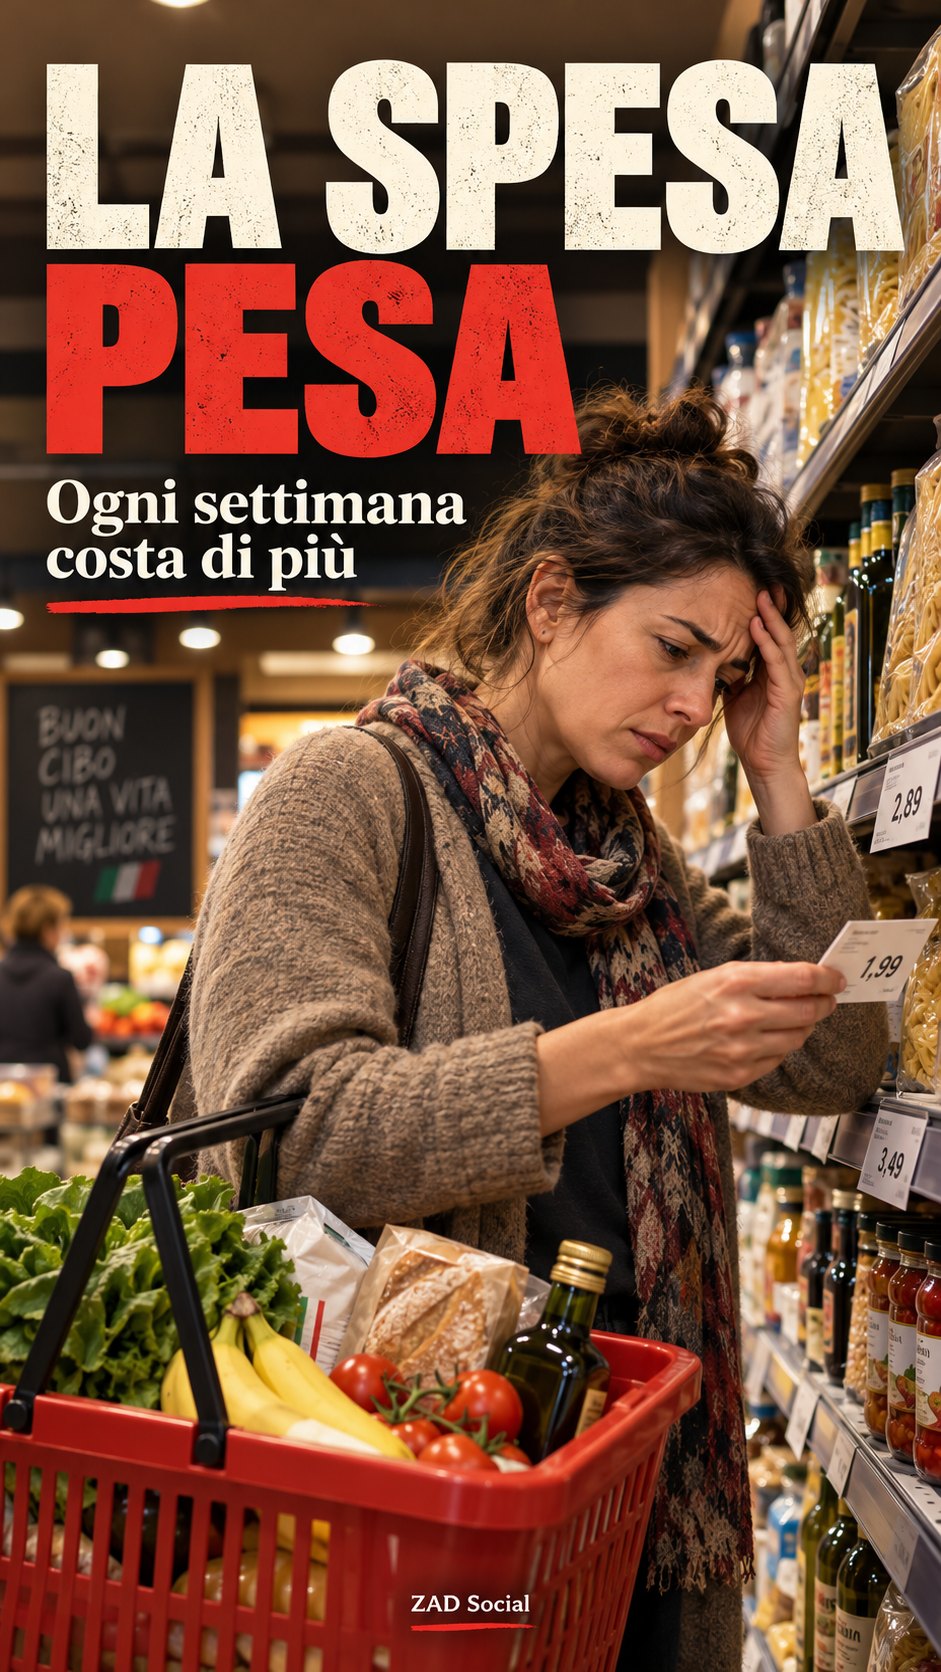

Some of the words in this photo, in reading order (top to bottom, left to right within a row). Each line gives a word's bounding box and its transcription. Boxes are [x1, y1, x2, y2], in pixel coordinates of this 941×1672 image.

[39, 705, 126, 747] BUON
[38, 745, 116, 786] CIBO
[42, 785, 102, 823] UNA
[110, 775, 173, 814] VITA
[890, 785, 923, 824] 2,89
[35, 815, 175, 865] MIGLIORE
[860, 955, 903, 982] 1,99
[877, 1146, 905, 1179] 3,49
